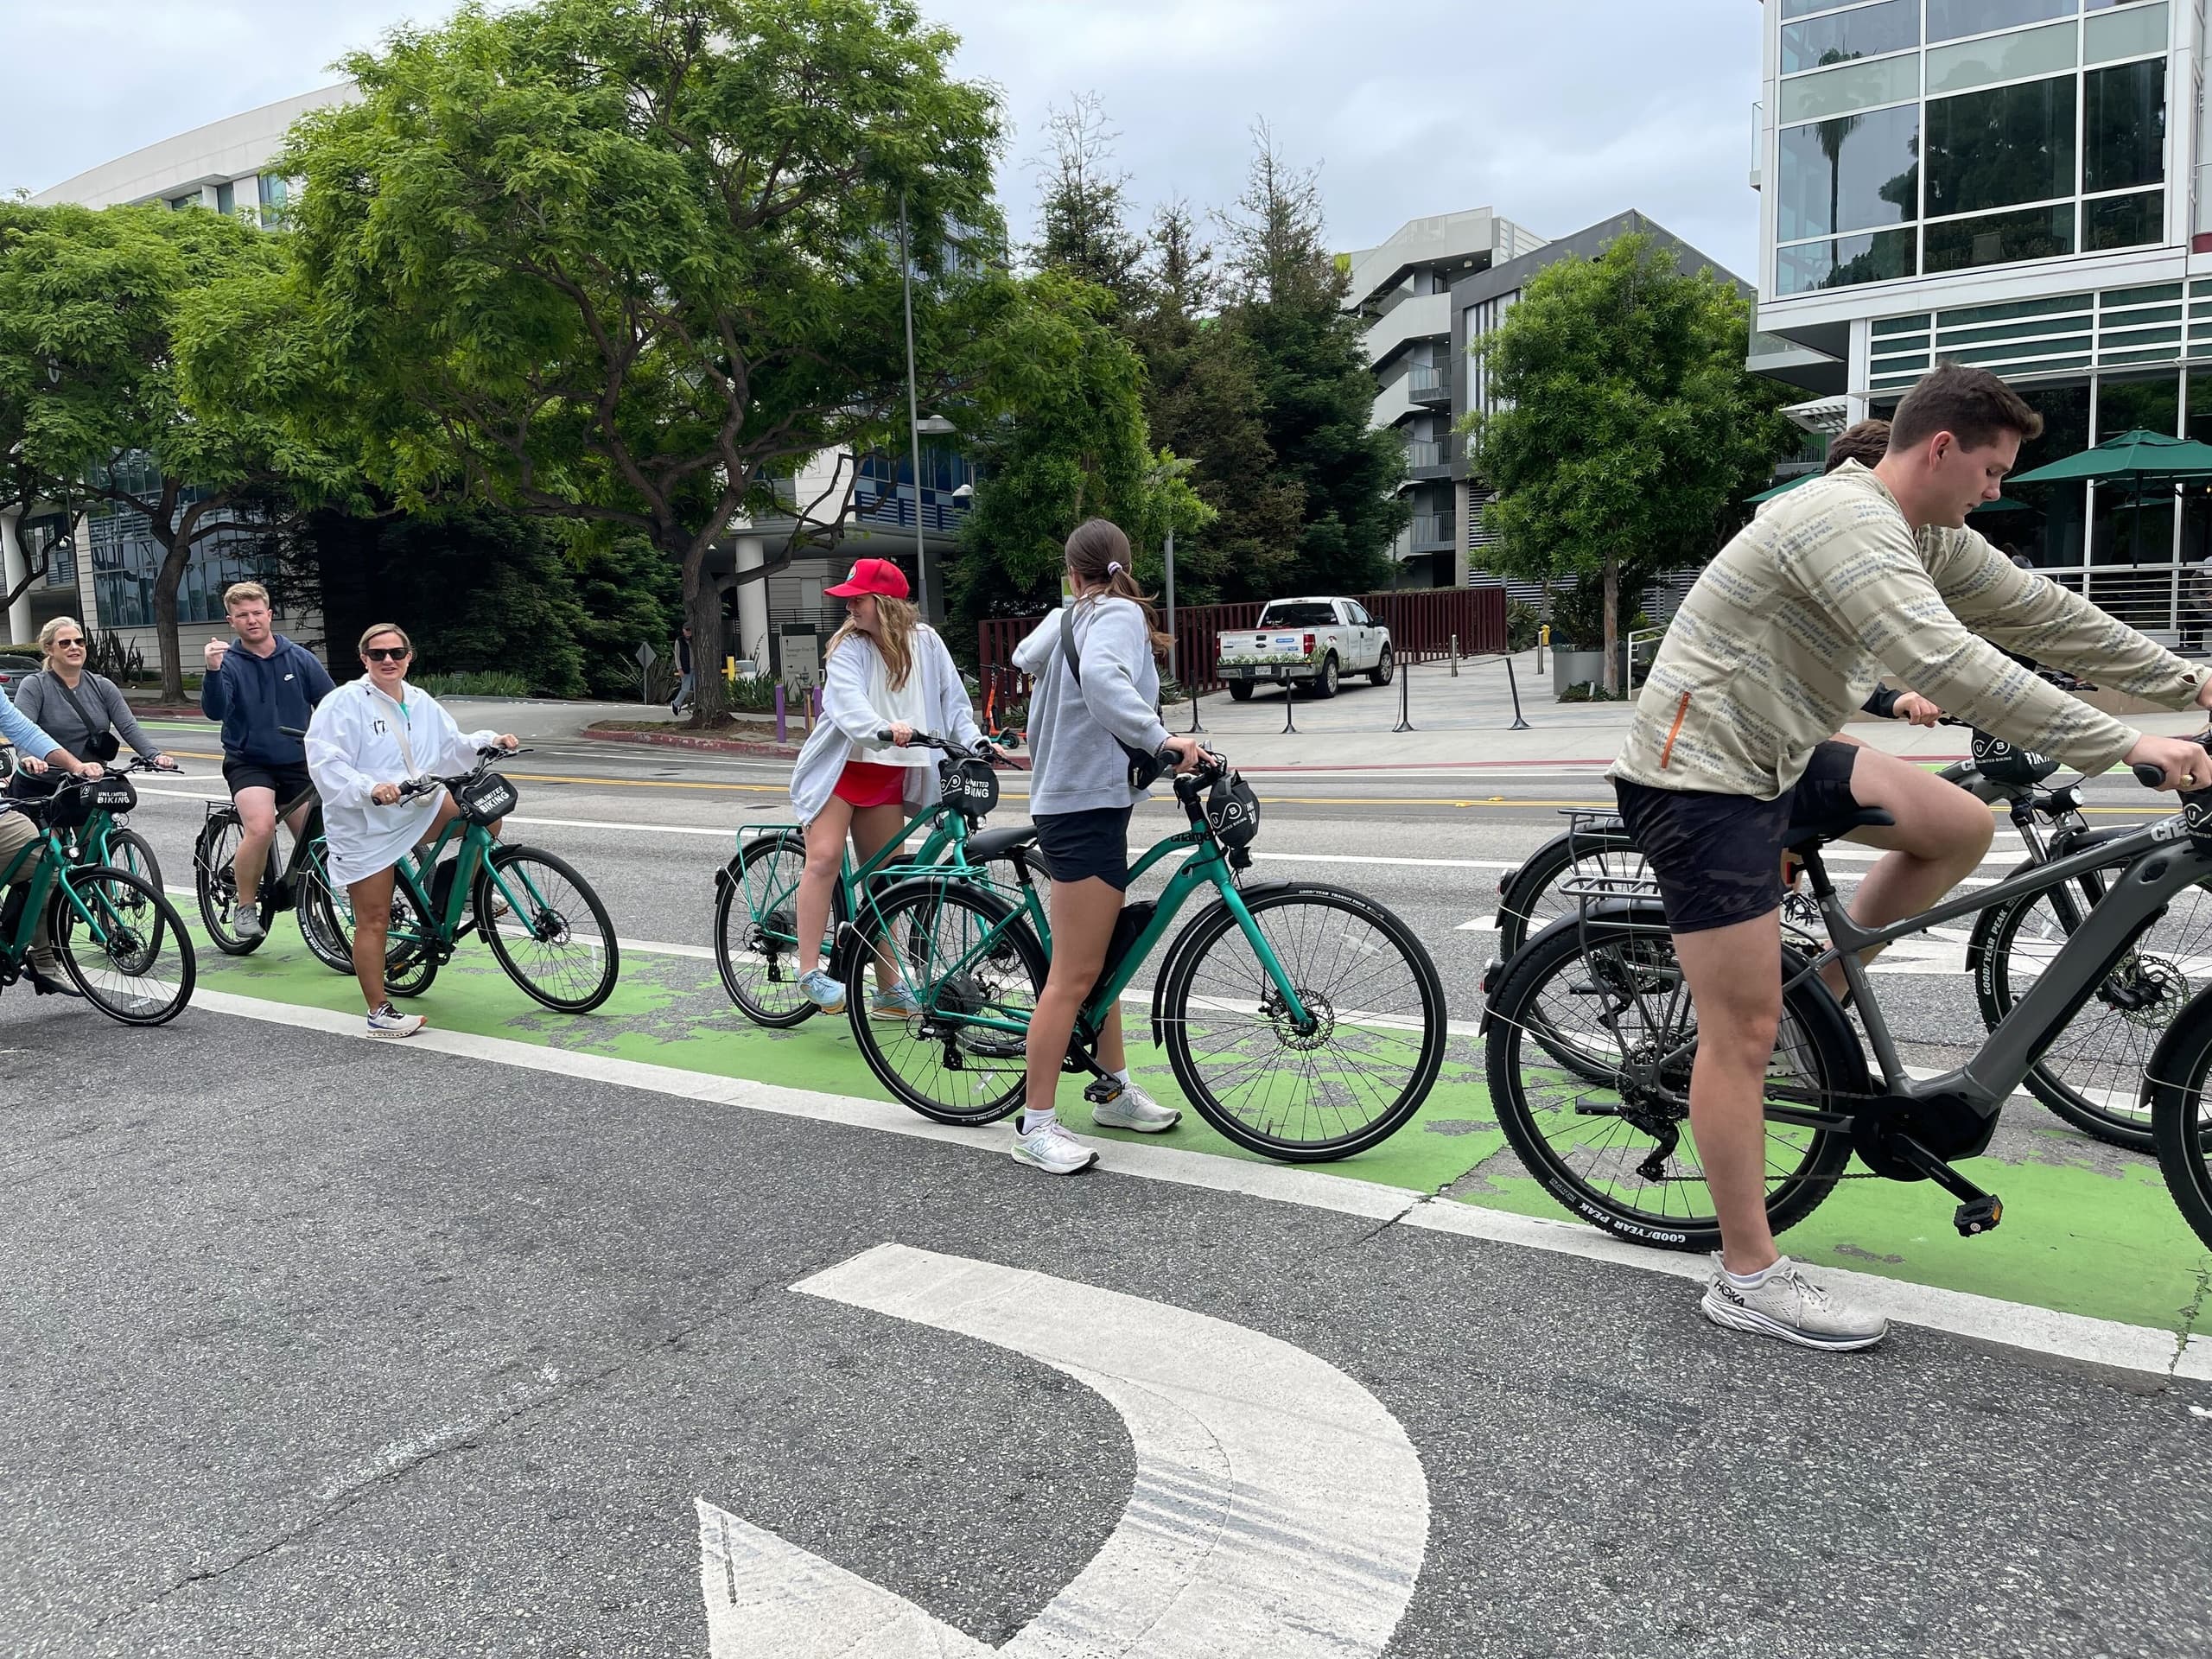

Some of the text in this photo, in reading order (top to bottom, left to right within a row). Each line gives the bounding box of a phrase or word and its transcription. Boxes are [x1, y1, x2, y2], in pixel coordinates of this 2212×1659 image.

[373, 720, 385, 735] 17
[1976, 741, 2005, 753] U B
[474, 785, 504, 807] UNLIMITED
[479, 791, 510, 813] BIKING
[1228, 806, 1237, 815] B
[2187, 810, 2196, 821] U
[1170, 831, 1211, 846] charge
[2150, 820, 2190, 842] cha
[1982, 908, 2008, 995] GOODYEAR PEAK
[1579, 1202, 1686, 1243] GOODYEAR PEAK
[1714, 1280, 1745, 1307] HOKA
